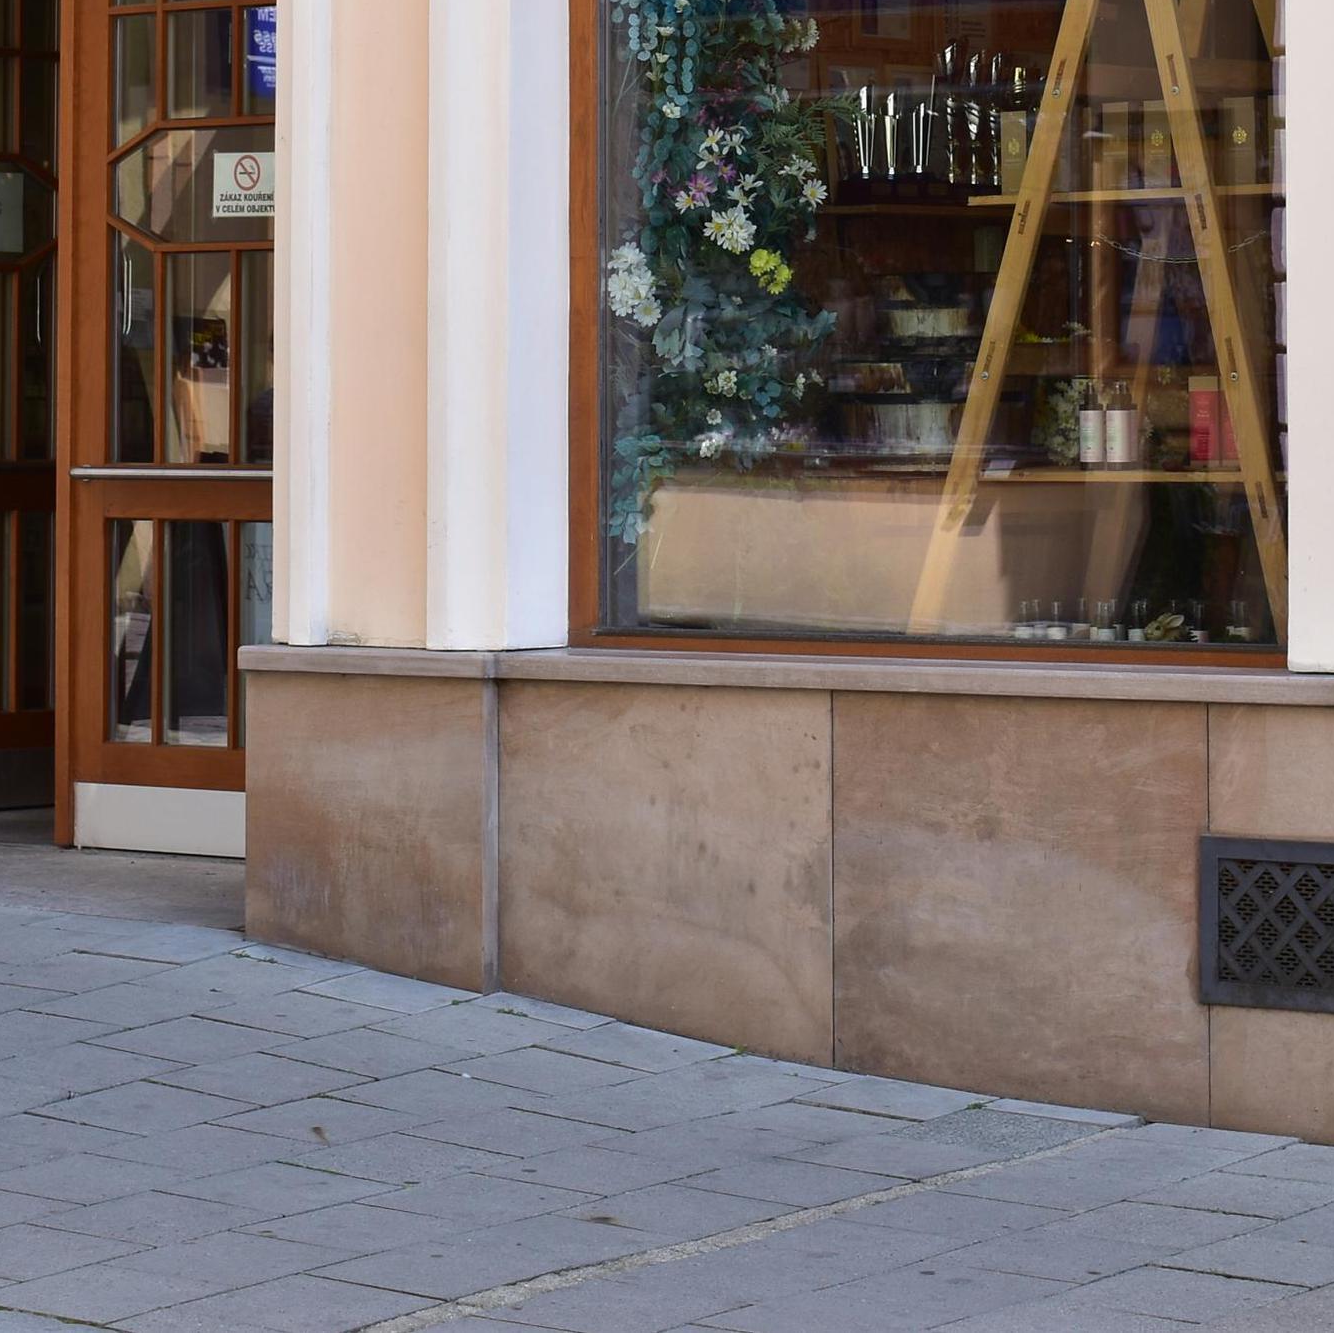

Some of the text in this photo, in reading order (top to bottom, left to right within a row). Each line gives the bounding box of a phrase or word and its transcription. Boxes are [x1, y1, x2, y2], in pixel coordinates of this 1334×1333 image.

[220, 191, 242, 202] ZÁKAZ
[216, 205, 220, 213] V
[222, 203, 245, 213] CELÉM
